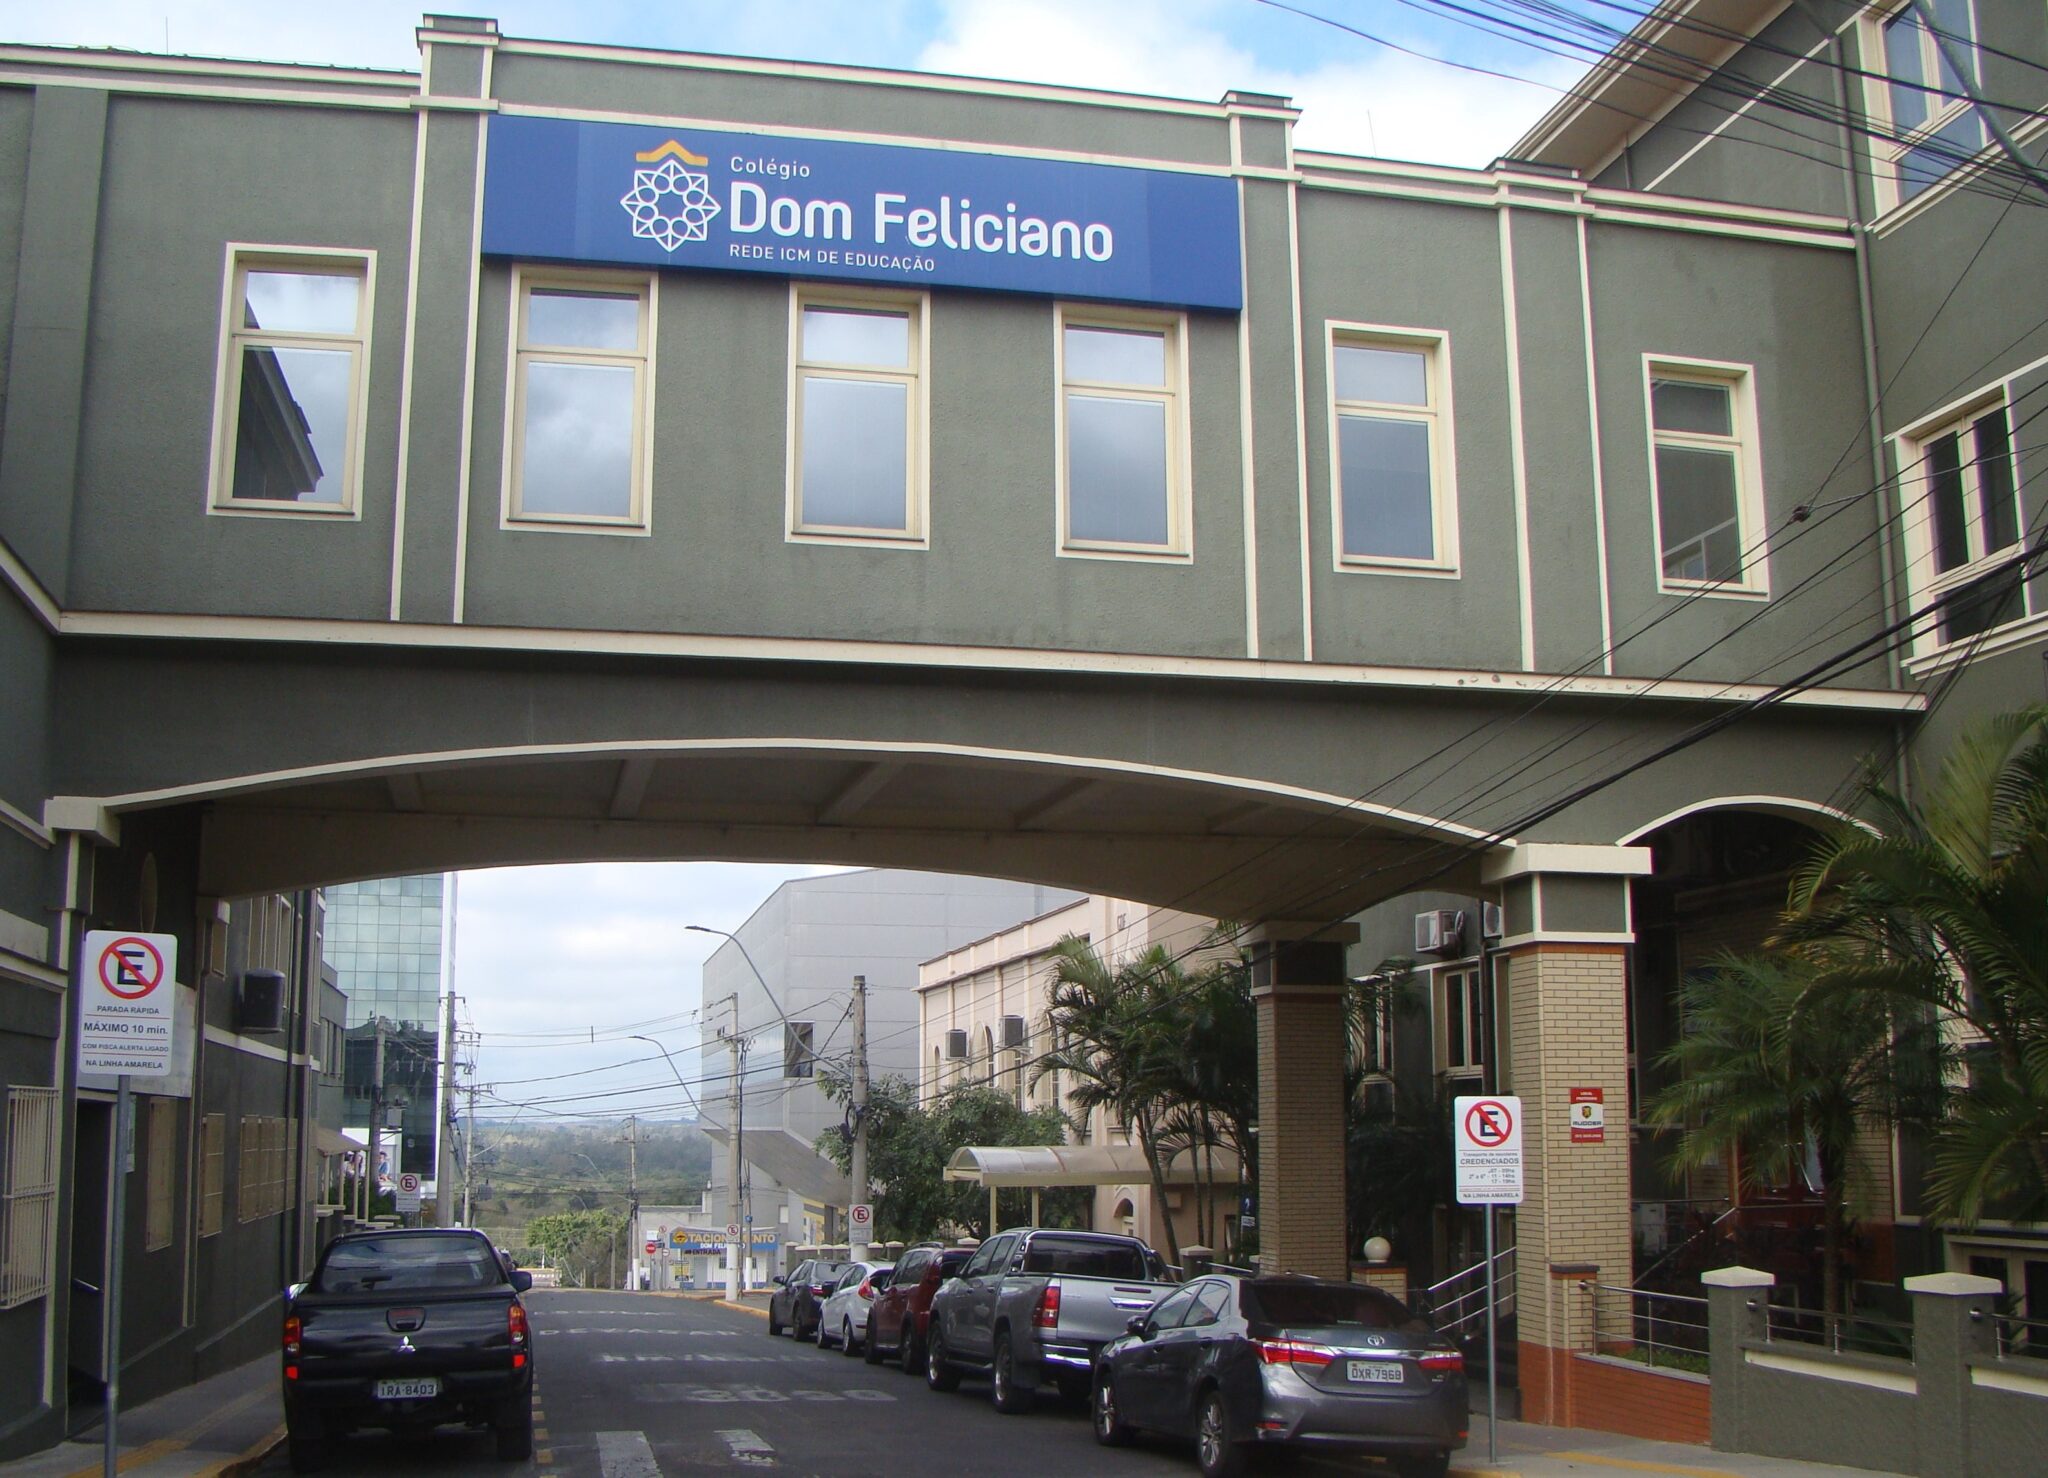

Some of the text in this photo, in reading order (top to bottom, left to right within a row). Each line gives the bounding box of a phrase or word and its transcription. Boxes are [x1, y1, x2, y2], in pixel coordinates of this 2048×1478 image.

[730, 156, 811, 180] Colégio
[730, 181, 1113, 262] Dom Feliciano
[730, 244, 935, 273] REDE ICM DE EDUCAÇÃO
[97, 1005, 129, 1013] PARADA
[83, 1021, 168, 1034] MÁXIMO 10 min.
[124, 1061, 163, 1069] AMARELA
